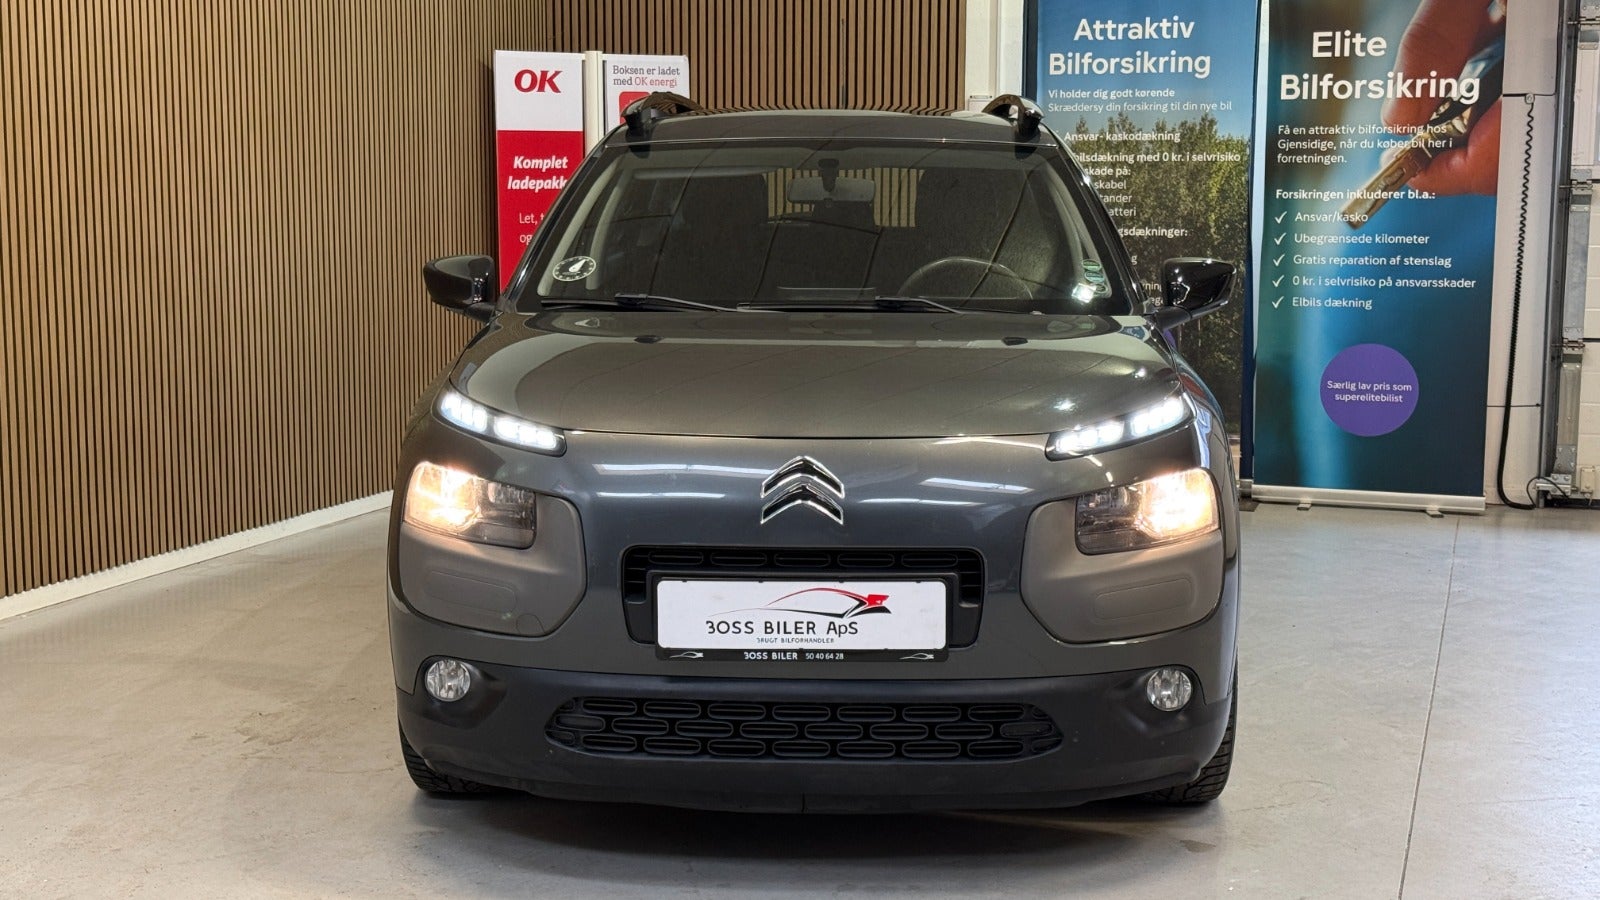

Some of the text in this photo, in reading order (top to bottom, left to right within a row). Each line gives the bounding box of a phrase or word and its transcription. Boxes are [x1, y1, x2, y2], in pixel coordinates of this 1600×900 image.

[1074, 15, 1195, 41] Attraktiv
[1312, 30, 1387, 57] Elite
[613, 65, 680, 75] Boksen er ladet
[1049, 50, 1211, 79] Bilforsikring
[514, 69, 562, 93] OK
[613, 76, 677, 87] med OK energi
[1049, 88, 1175, 99] Vi holder dig godt kørende
[1280, 71, 1480, 105] Bilforsikring
[1049, 101, 1232, 114] Skræddersy din forsikring til din nye bil
[1278, 124, 1446, 135] Få en attraktiv bilforsikring hos
[1064, 131, 1181, 142] Ansvar- kaskodækning
[1278, 138, 1452, 151] Gjensidige, når du køber bil her i
[513, 155, 568, 172] Komplet
[1074, 153, 1240, 164] bilsdækning med 0 kr. i selvrisiko
[1278, 153, 1347, 164] forretningen.
[1116, 167, 1131, 178] på:
[507, 176, 568, 193] ladepakk
[1095, 180, 1127, 189] skabel
[1100, 194, 1132, 203] tander
[1275, 189, 1344, 200] Forsikringen
[1346, 189, 1405, 200] inkluderer
[1108, 207, 1136, 217] atteri
[1294, 211, 1368, 223] Ansvar/kasko
[519, 213, 537, 225] Let,
[1118, 227, 1187, 238] gsdækninger:
[1294, 234, 1429, 245] Ubegrænsede kilometer
[1293, 255, 1451, 268] Gratis reparation af stenslag
[1292, 276, 1475, 289] 0 kr. i selvrisiko på ansvarsskader
[1292, 297, 1372, 310] Elbils dækning
[1327, 381, 1356, 392] Særlig
[1358, 381, 1371, 391] lav
[1373, 382, 1391, 393] pris
[1335, 393, 1403, 403] superelitebilist
[764, 621, 816, 634] BILER
[827, 621, 858, 638] ApS
[772, 652, 798, 660] BILER
[806, 652, 814, 660] 50
[815, 652, 824, 660] 40
[824, 652, 834, 660] 64
[835, 652, 844, 660] 28
